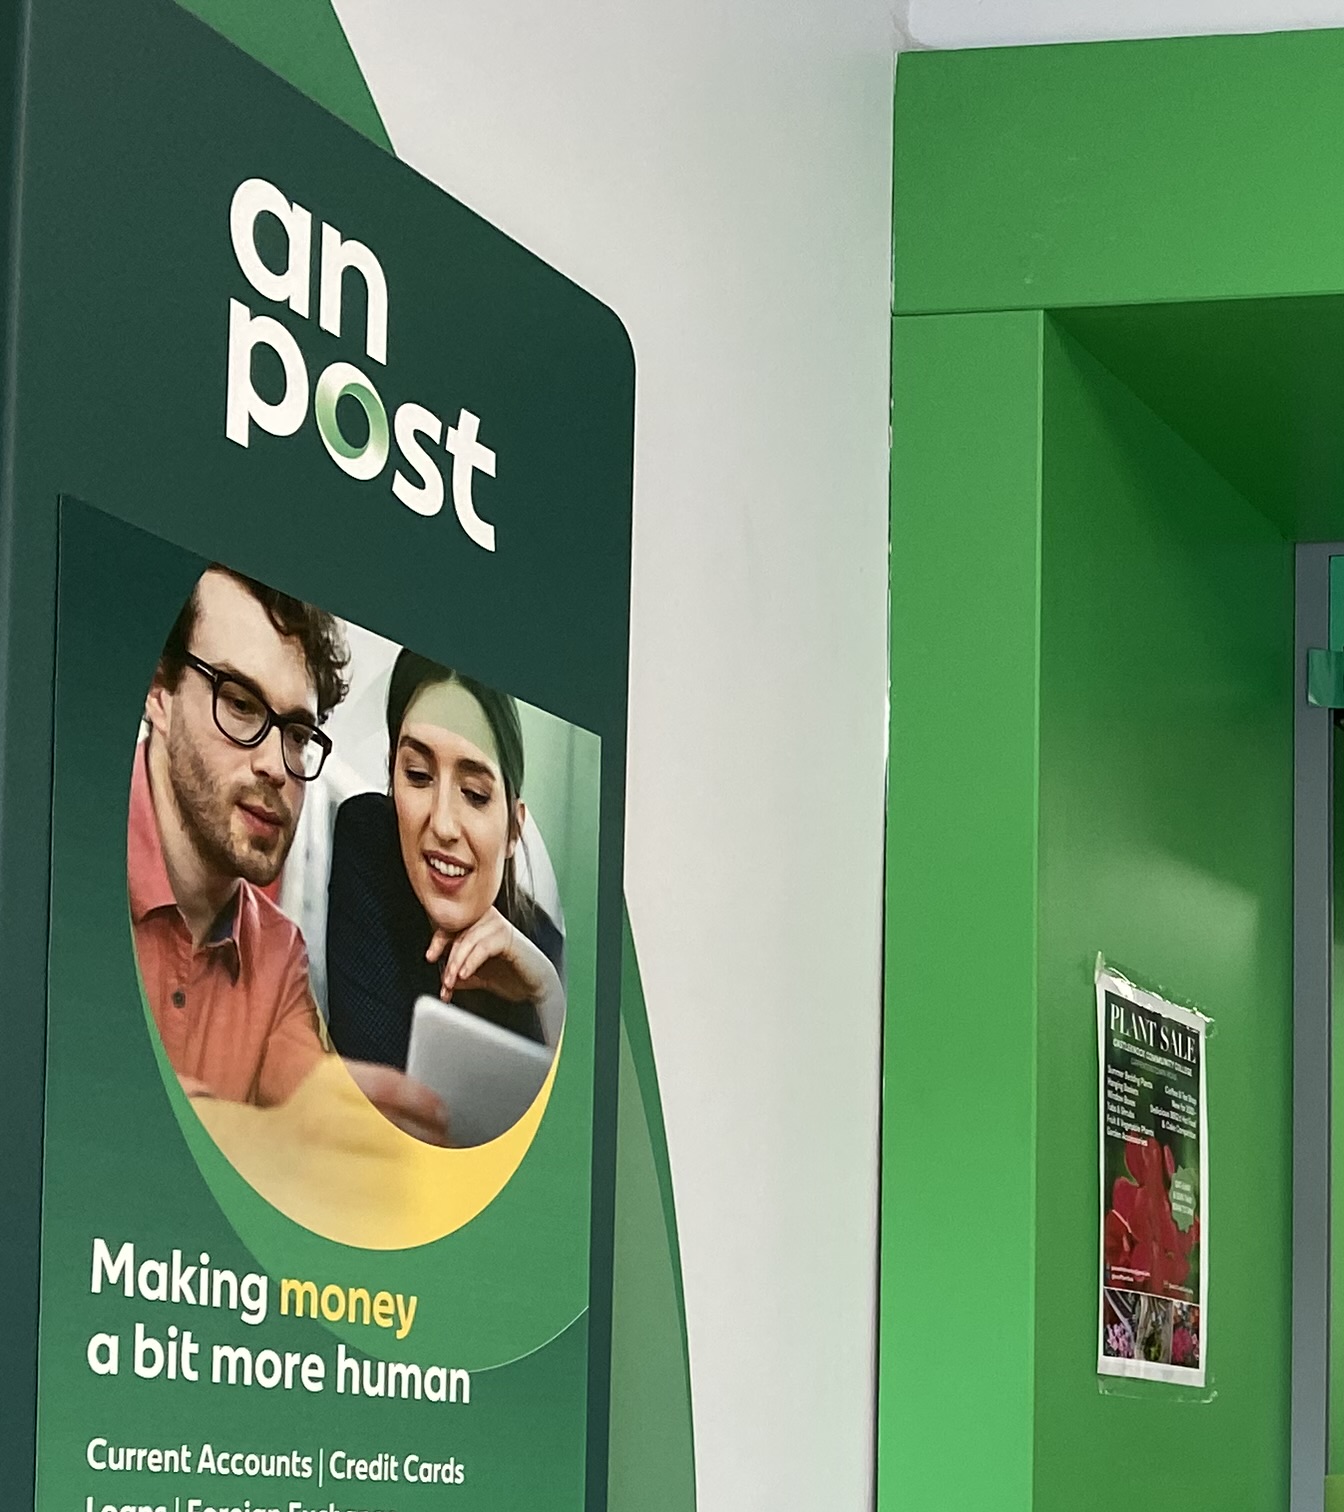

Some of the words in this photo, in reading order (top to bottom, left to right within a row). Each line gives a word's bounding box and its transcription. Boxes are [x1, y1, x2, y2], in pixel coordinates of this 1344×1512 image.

[230, 178, 388, 366] an
[226, 297, 496, 552] post
[1110, 1003, 1157, 1048] PLANT
[1160, 1024, 1196, 1064] SALE
[91, 1238, 268, 1324] Making
[280, 1278, 417, 1339] money
[87, 1332, 119, 1375] a
[134, 1323, 199, 1381] bit
[211, 1344, 325, 1392] more
[336, 1344, 471, 1404] human
[86, 1438, 191, 1473] Current
[197, 1444, 312, 1478] Accounts
[329, 1451, 398, 1481] Credit
[403, 1455, 464, 1484] Cards
